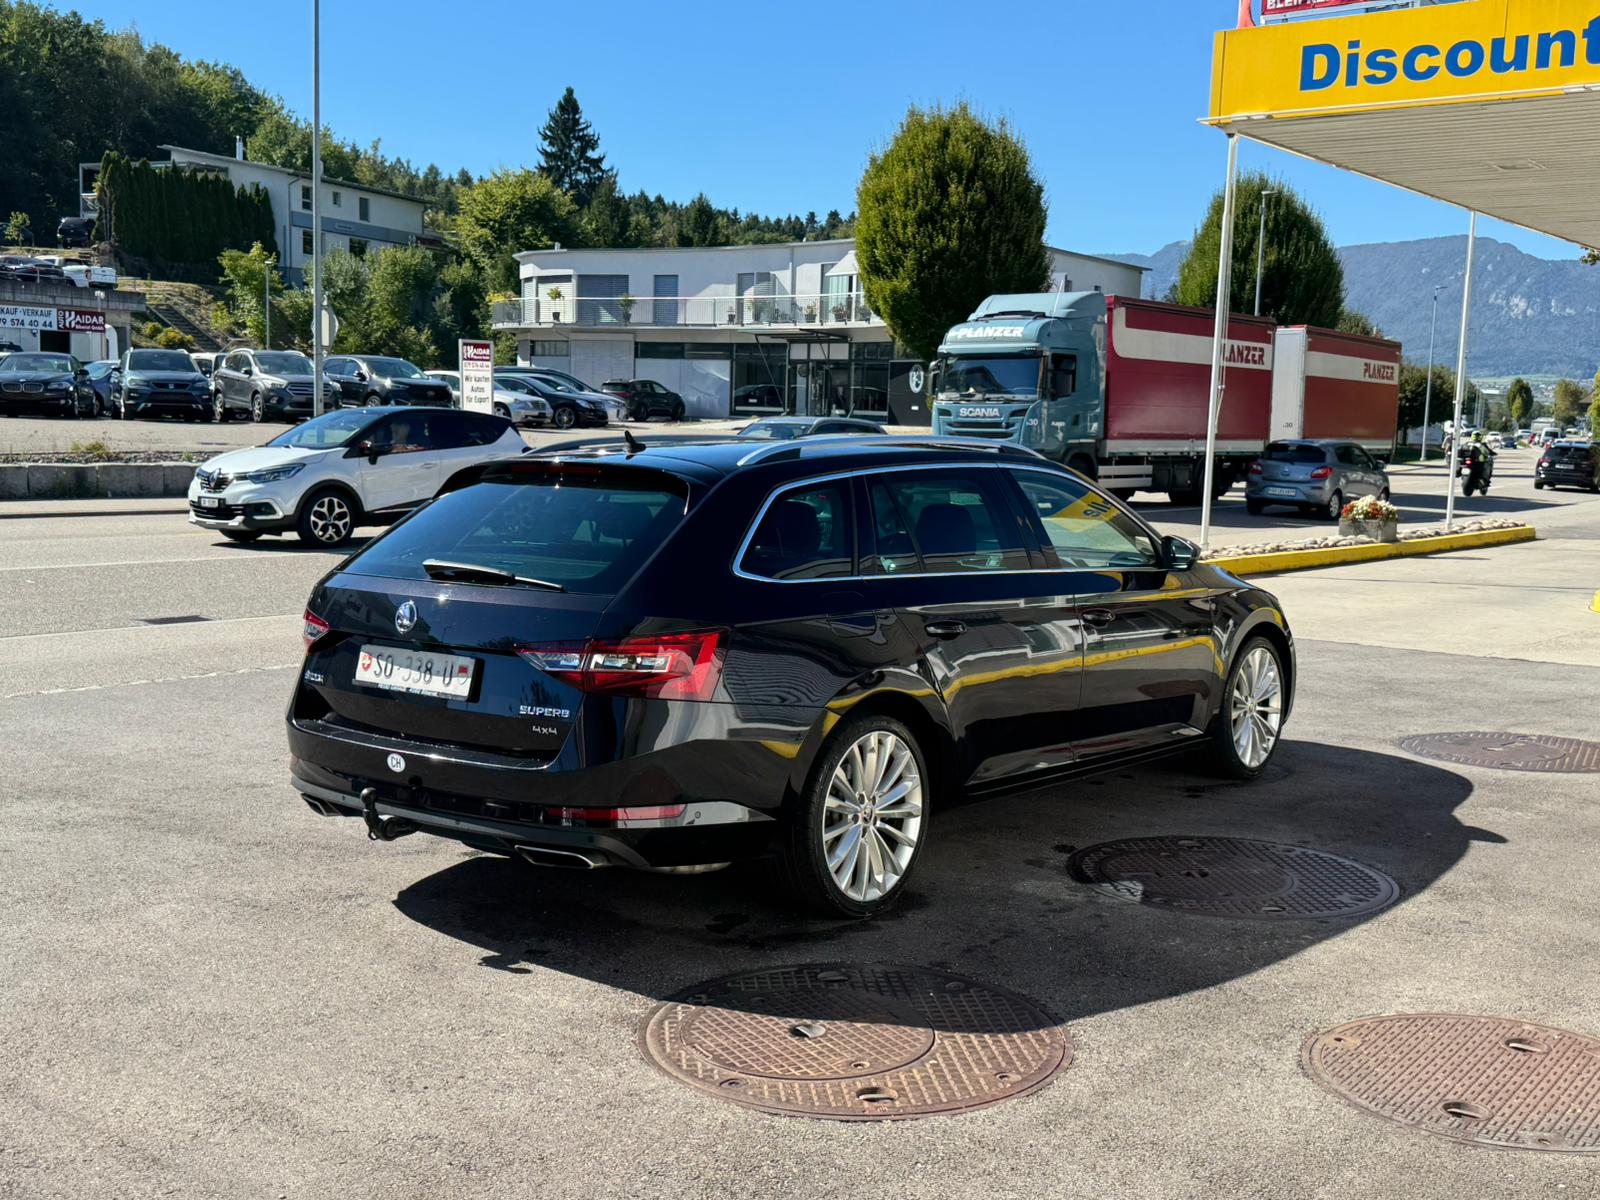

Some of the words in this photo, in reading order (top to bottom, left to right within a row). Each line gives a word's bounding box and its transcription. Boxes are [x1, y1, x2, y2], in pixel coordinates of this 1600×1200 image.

[1300, 15, 1600, 91] Discount
[10, 318, 25, 327] 574
[28, 319, 39, 328] 40
[42, 320, 53, 329] 44
[957, 326, 1025, 338] PLANZER
[1222, 343, 1265, 366] LANZER
[1363, 362, 1395, 381] PLANZER
[959, 407, 1000, 417] SCANIA
[519, 705, 570, 718] SUPERB
[532, 725, 558, 735] 4x4
[390, 756, 402, 769] CH
